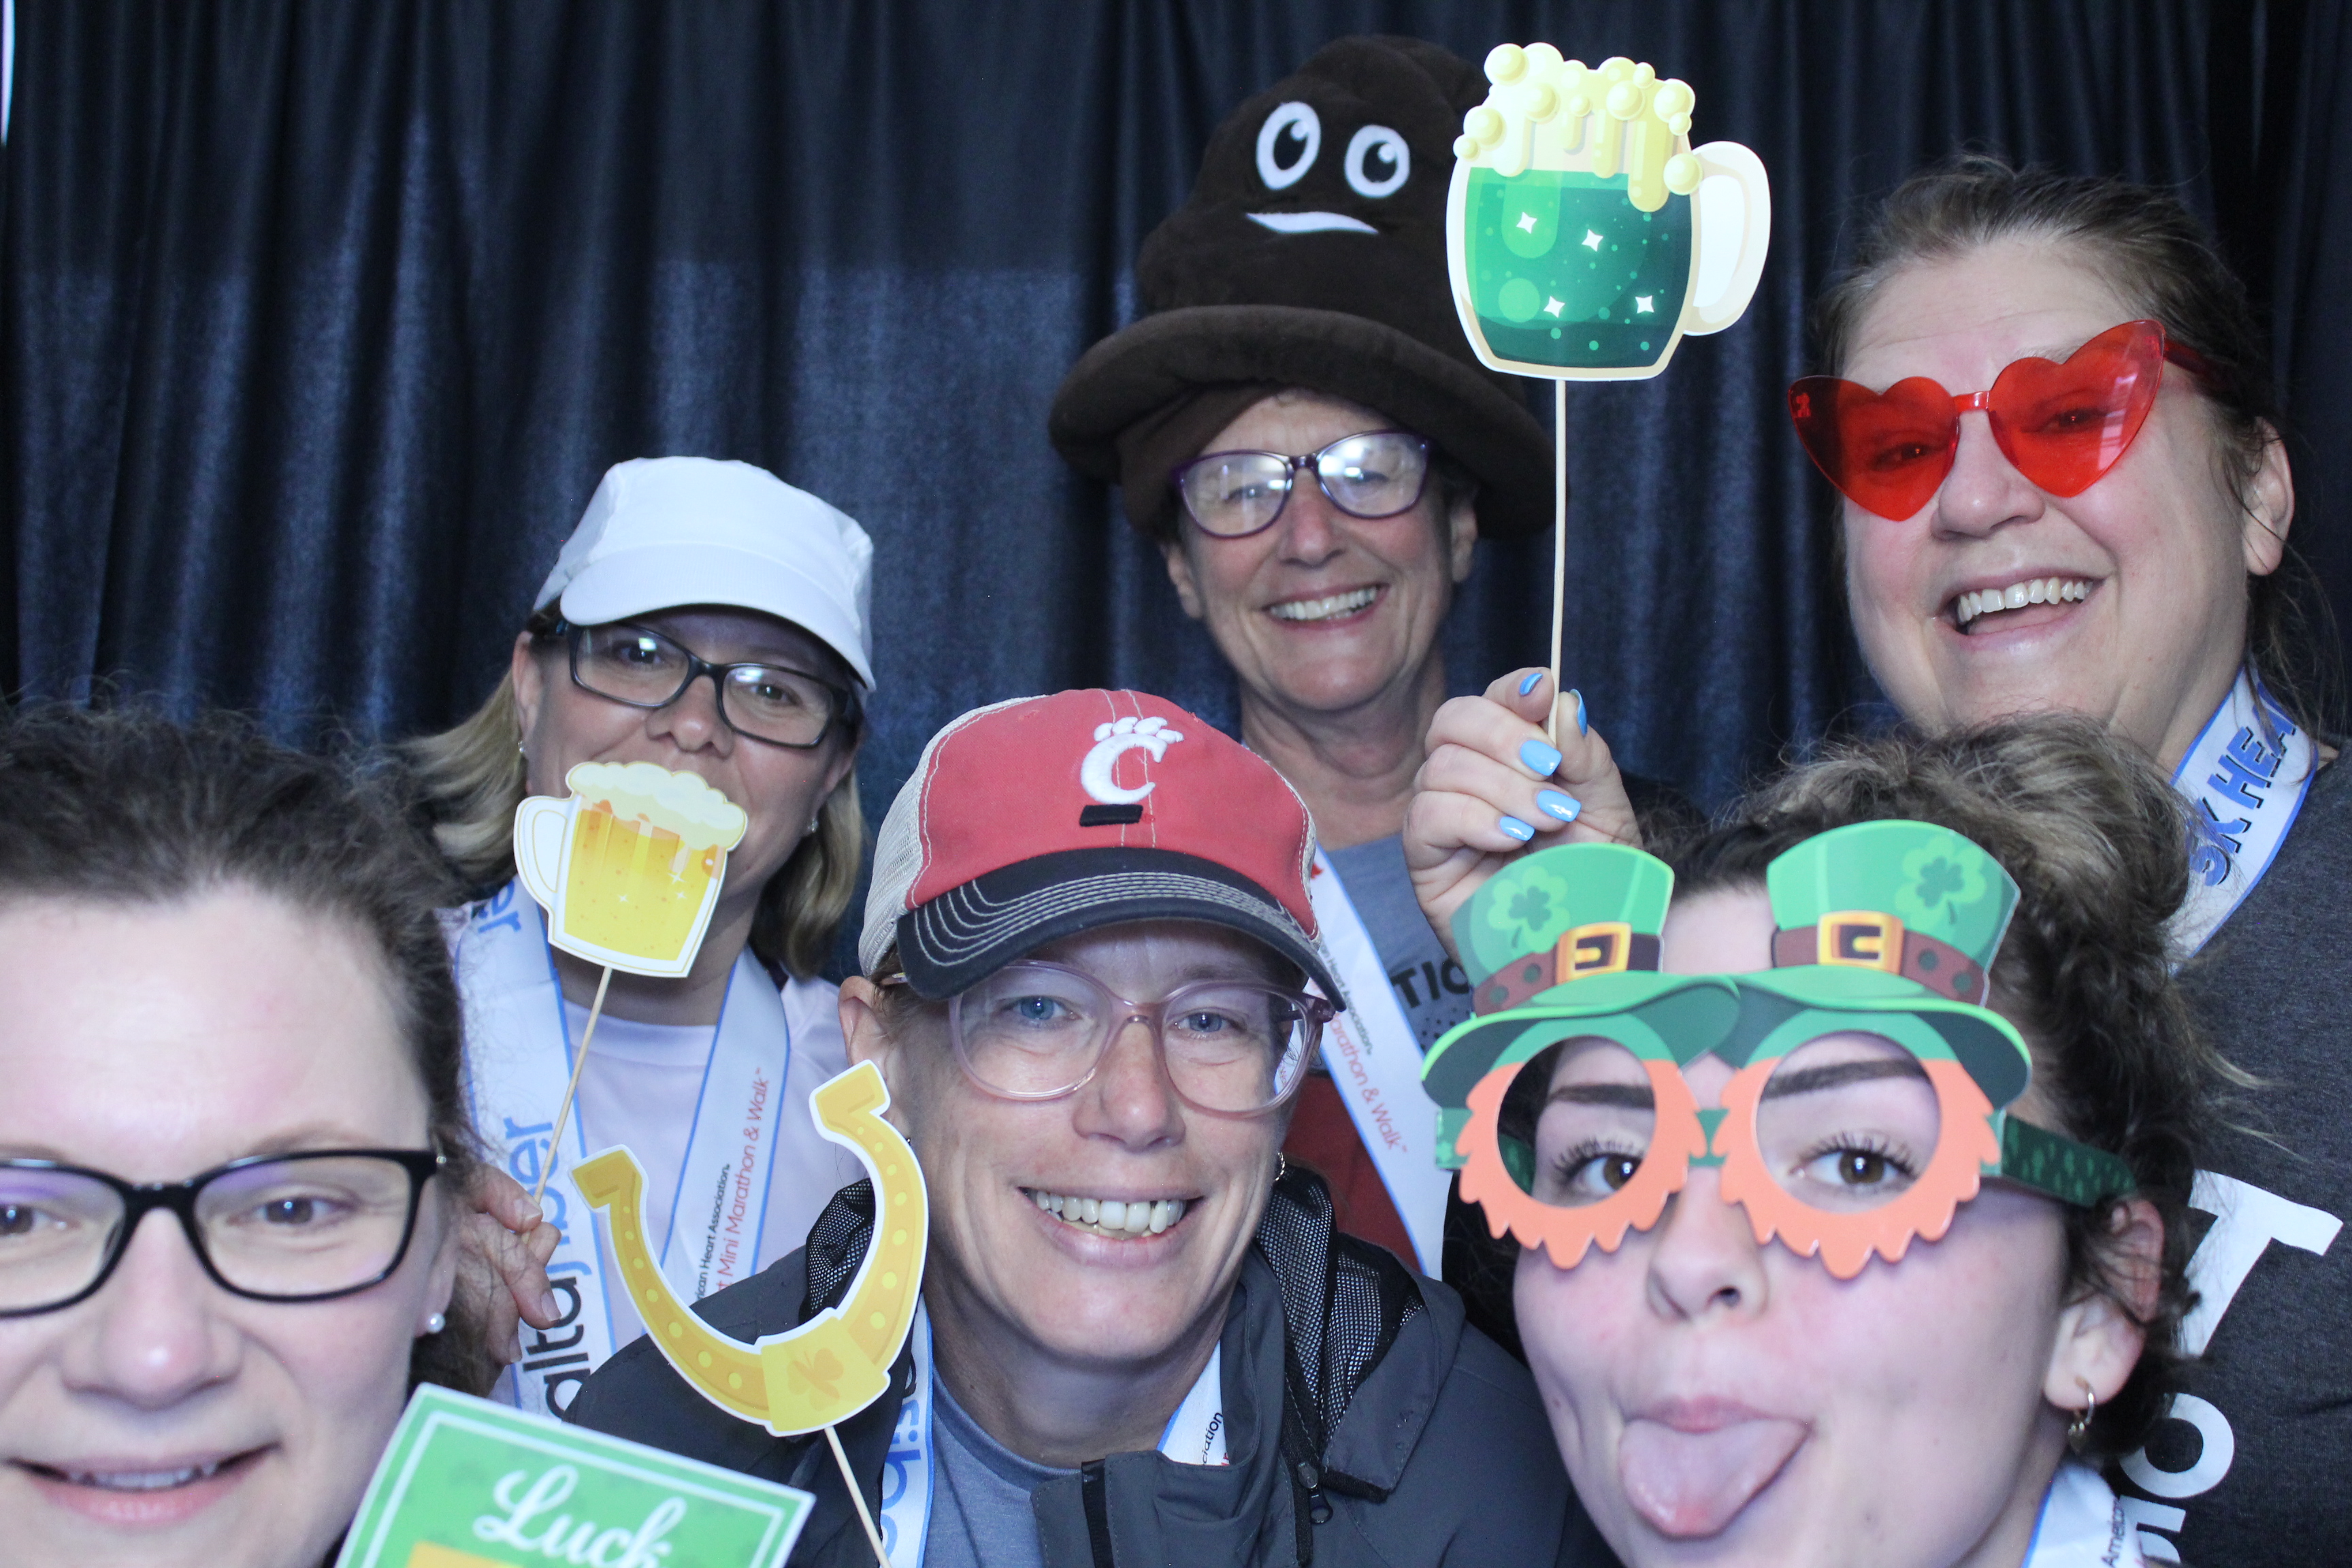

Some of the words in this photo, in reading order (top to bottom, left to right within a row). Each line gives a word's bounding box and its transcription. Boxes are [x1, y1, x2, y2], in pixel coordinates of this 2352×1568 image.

[1362, 1088, 1379, 1103] &
[744, 1126, 761, 1142] &
[725, 1144, 756, 1235] Marathon
[699, 1235, 716, 1269] Heart
[717, 1237, 740, 1277] Mini
[474, 1464, 686, 1568] Luck
